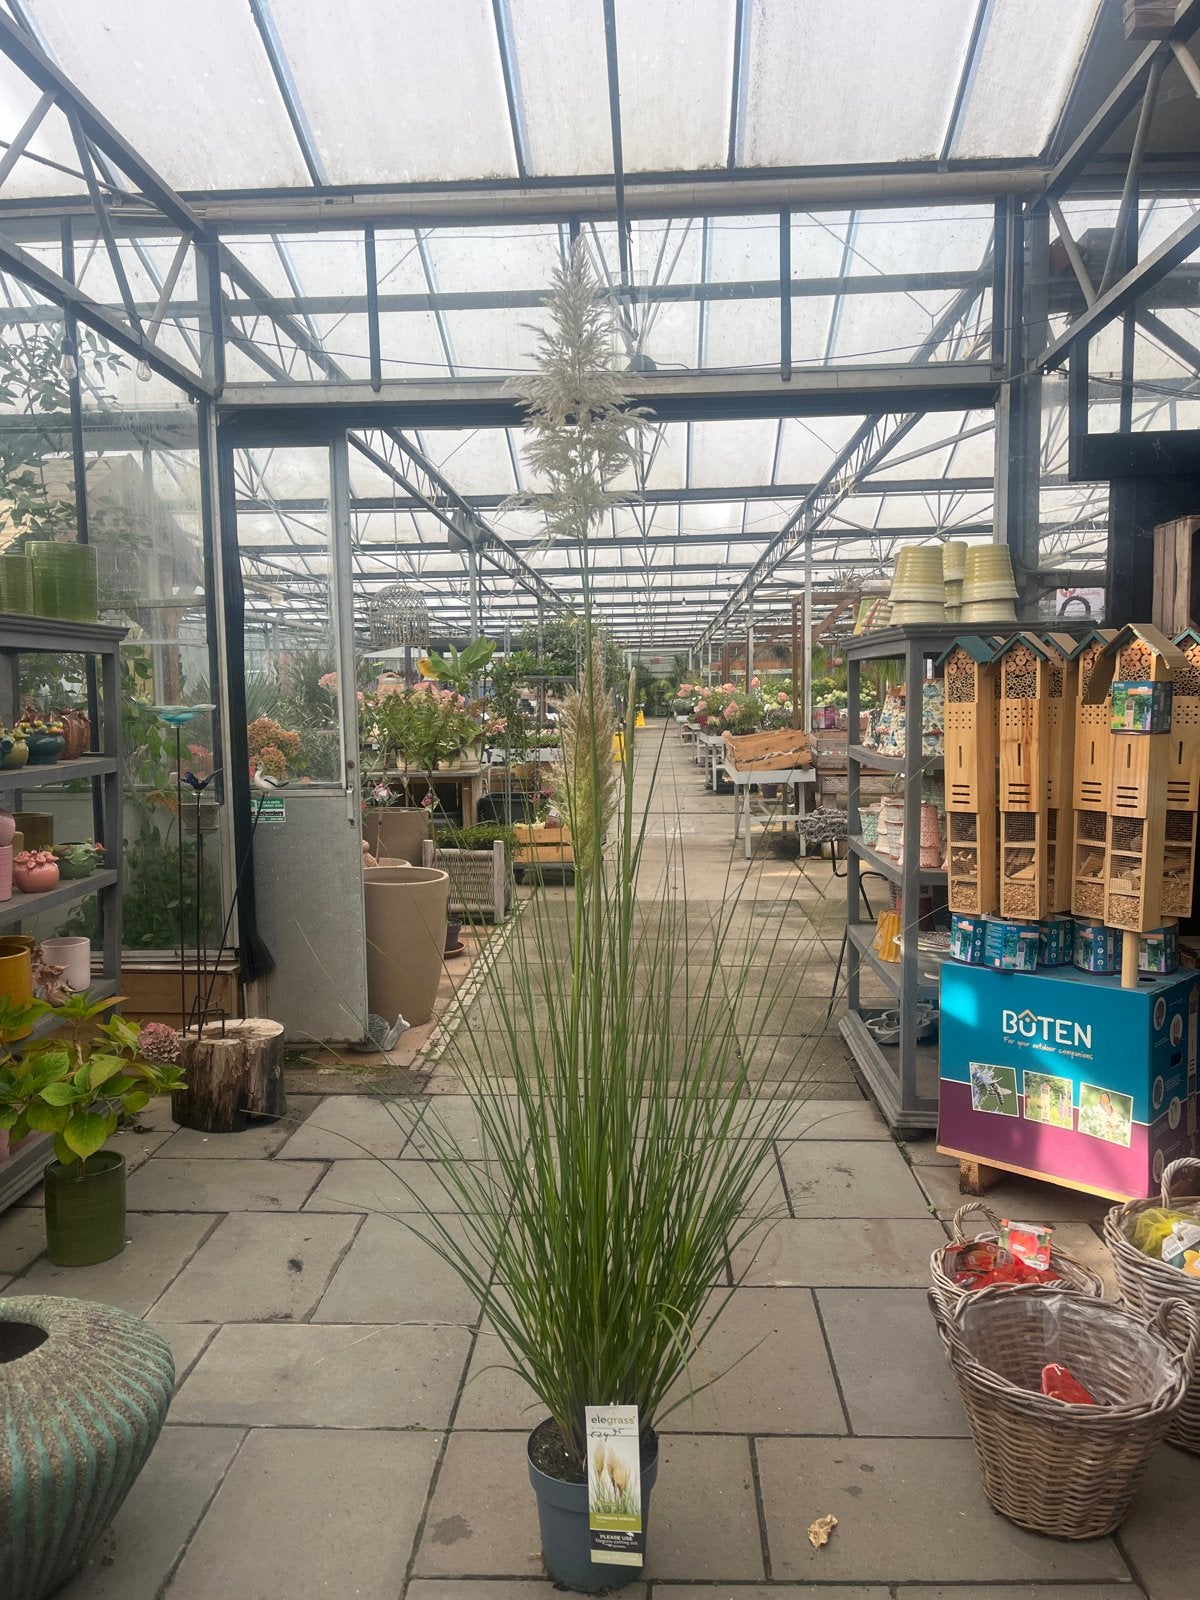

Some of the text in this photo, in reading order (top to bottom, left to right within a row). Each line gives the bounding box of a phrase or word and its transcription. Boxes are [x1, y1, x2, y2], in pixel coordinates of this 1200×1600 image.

[1003, 1036, 1093, 1061] For your outdoor companions
